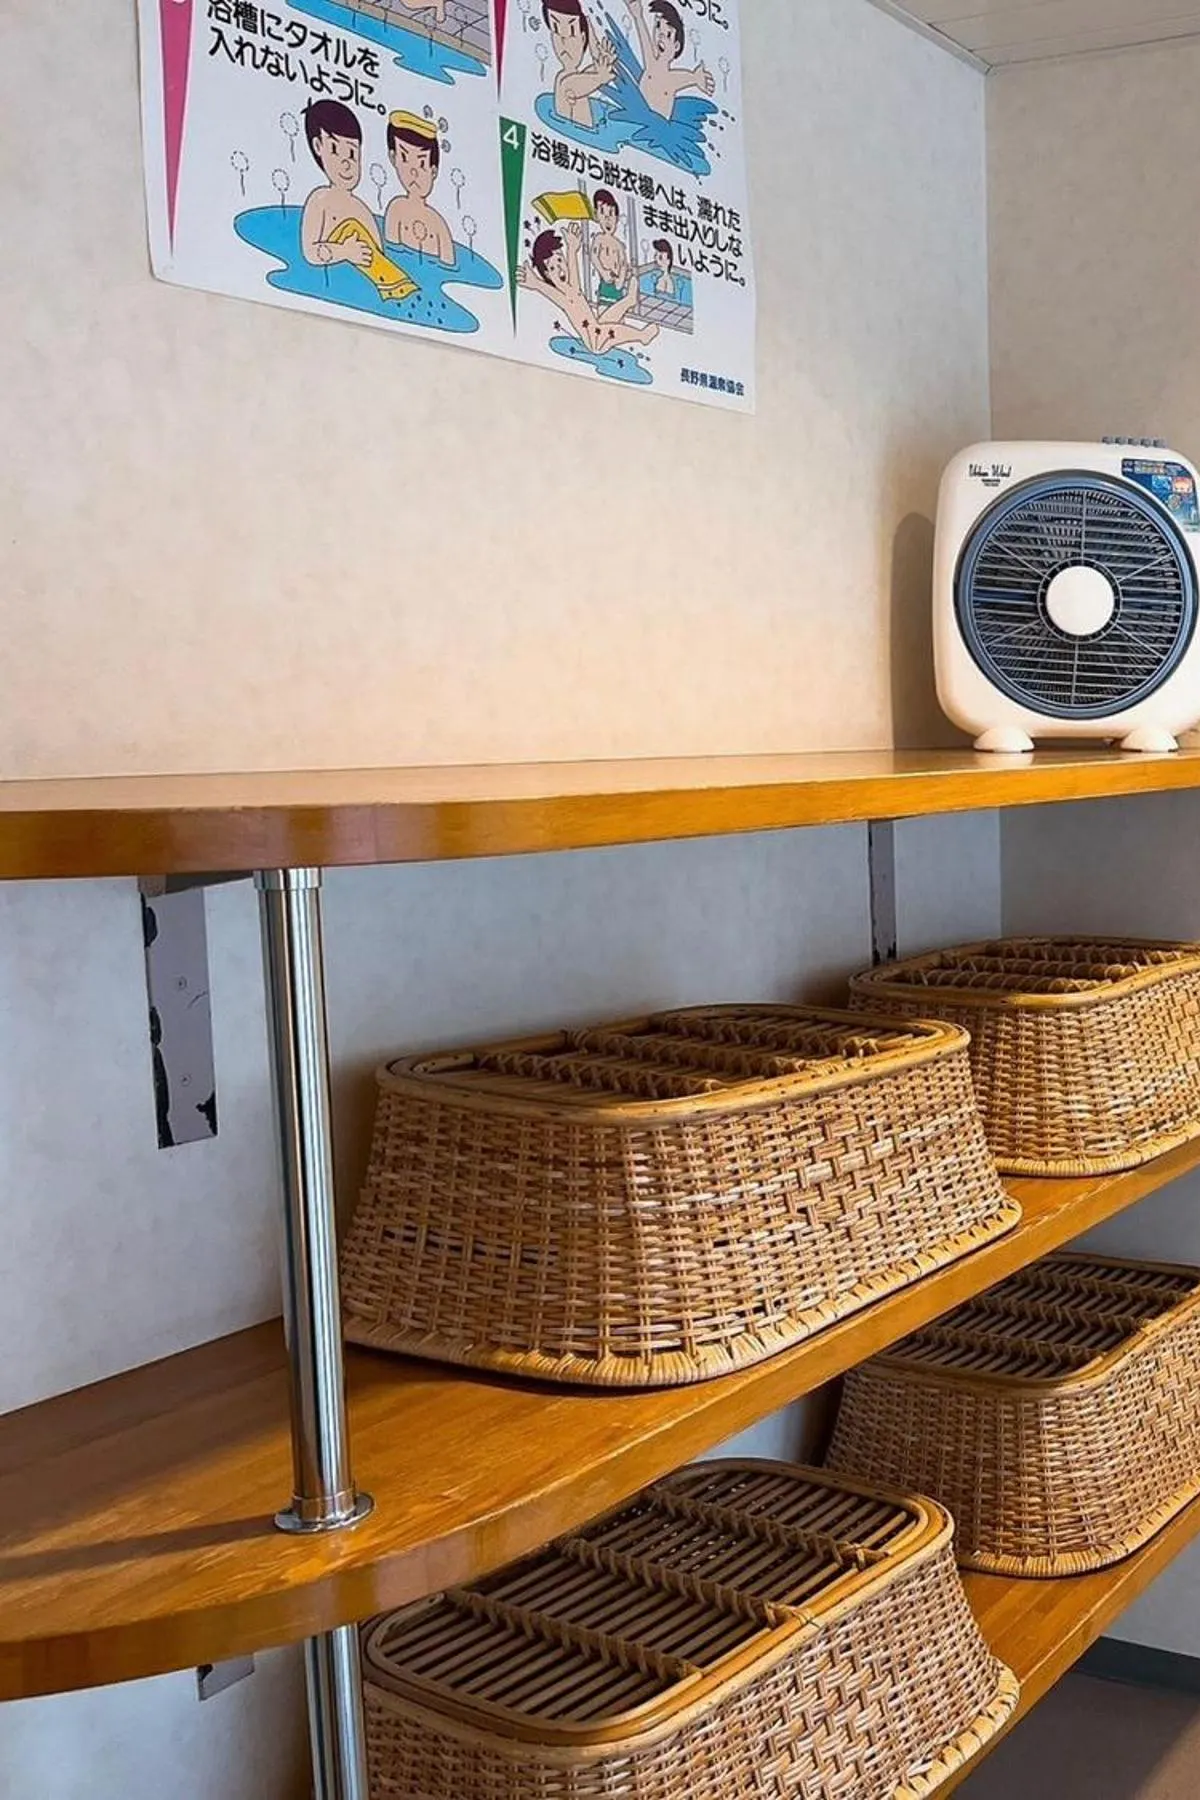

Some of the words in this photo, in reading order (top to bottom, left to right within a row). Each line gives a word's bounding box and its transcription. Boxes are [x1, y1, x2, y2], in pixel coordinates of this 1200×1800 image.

[207, 0, 380, 79] 浴槽にタオルを
[208, 26, 387, 116] 入れないように。
[503, 125, 519, 149] 4
[531, 131, 741, 233] 浴場から脱衣場へは、濡れた
[642, 205, 743, 258] まま出入りしな
[677, 243, 746, 287] いように。
